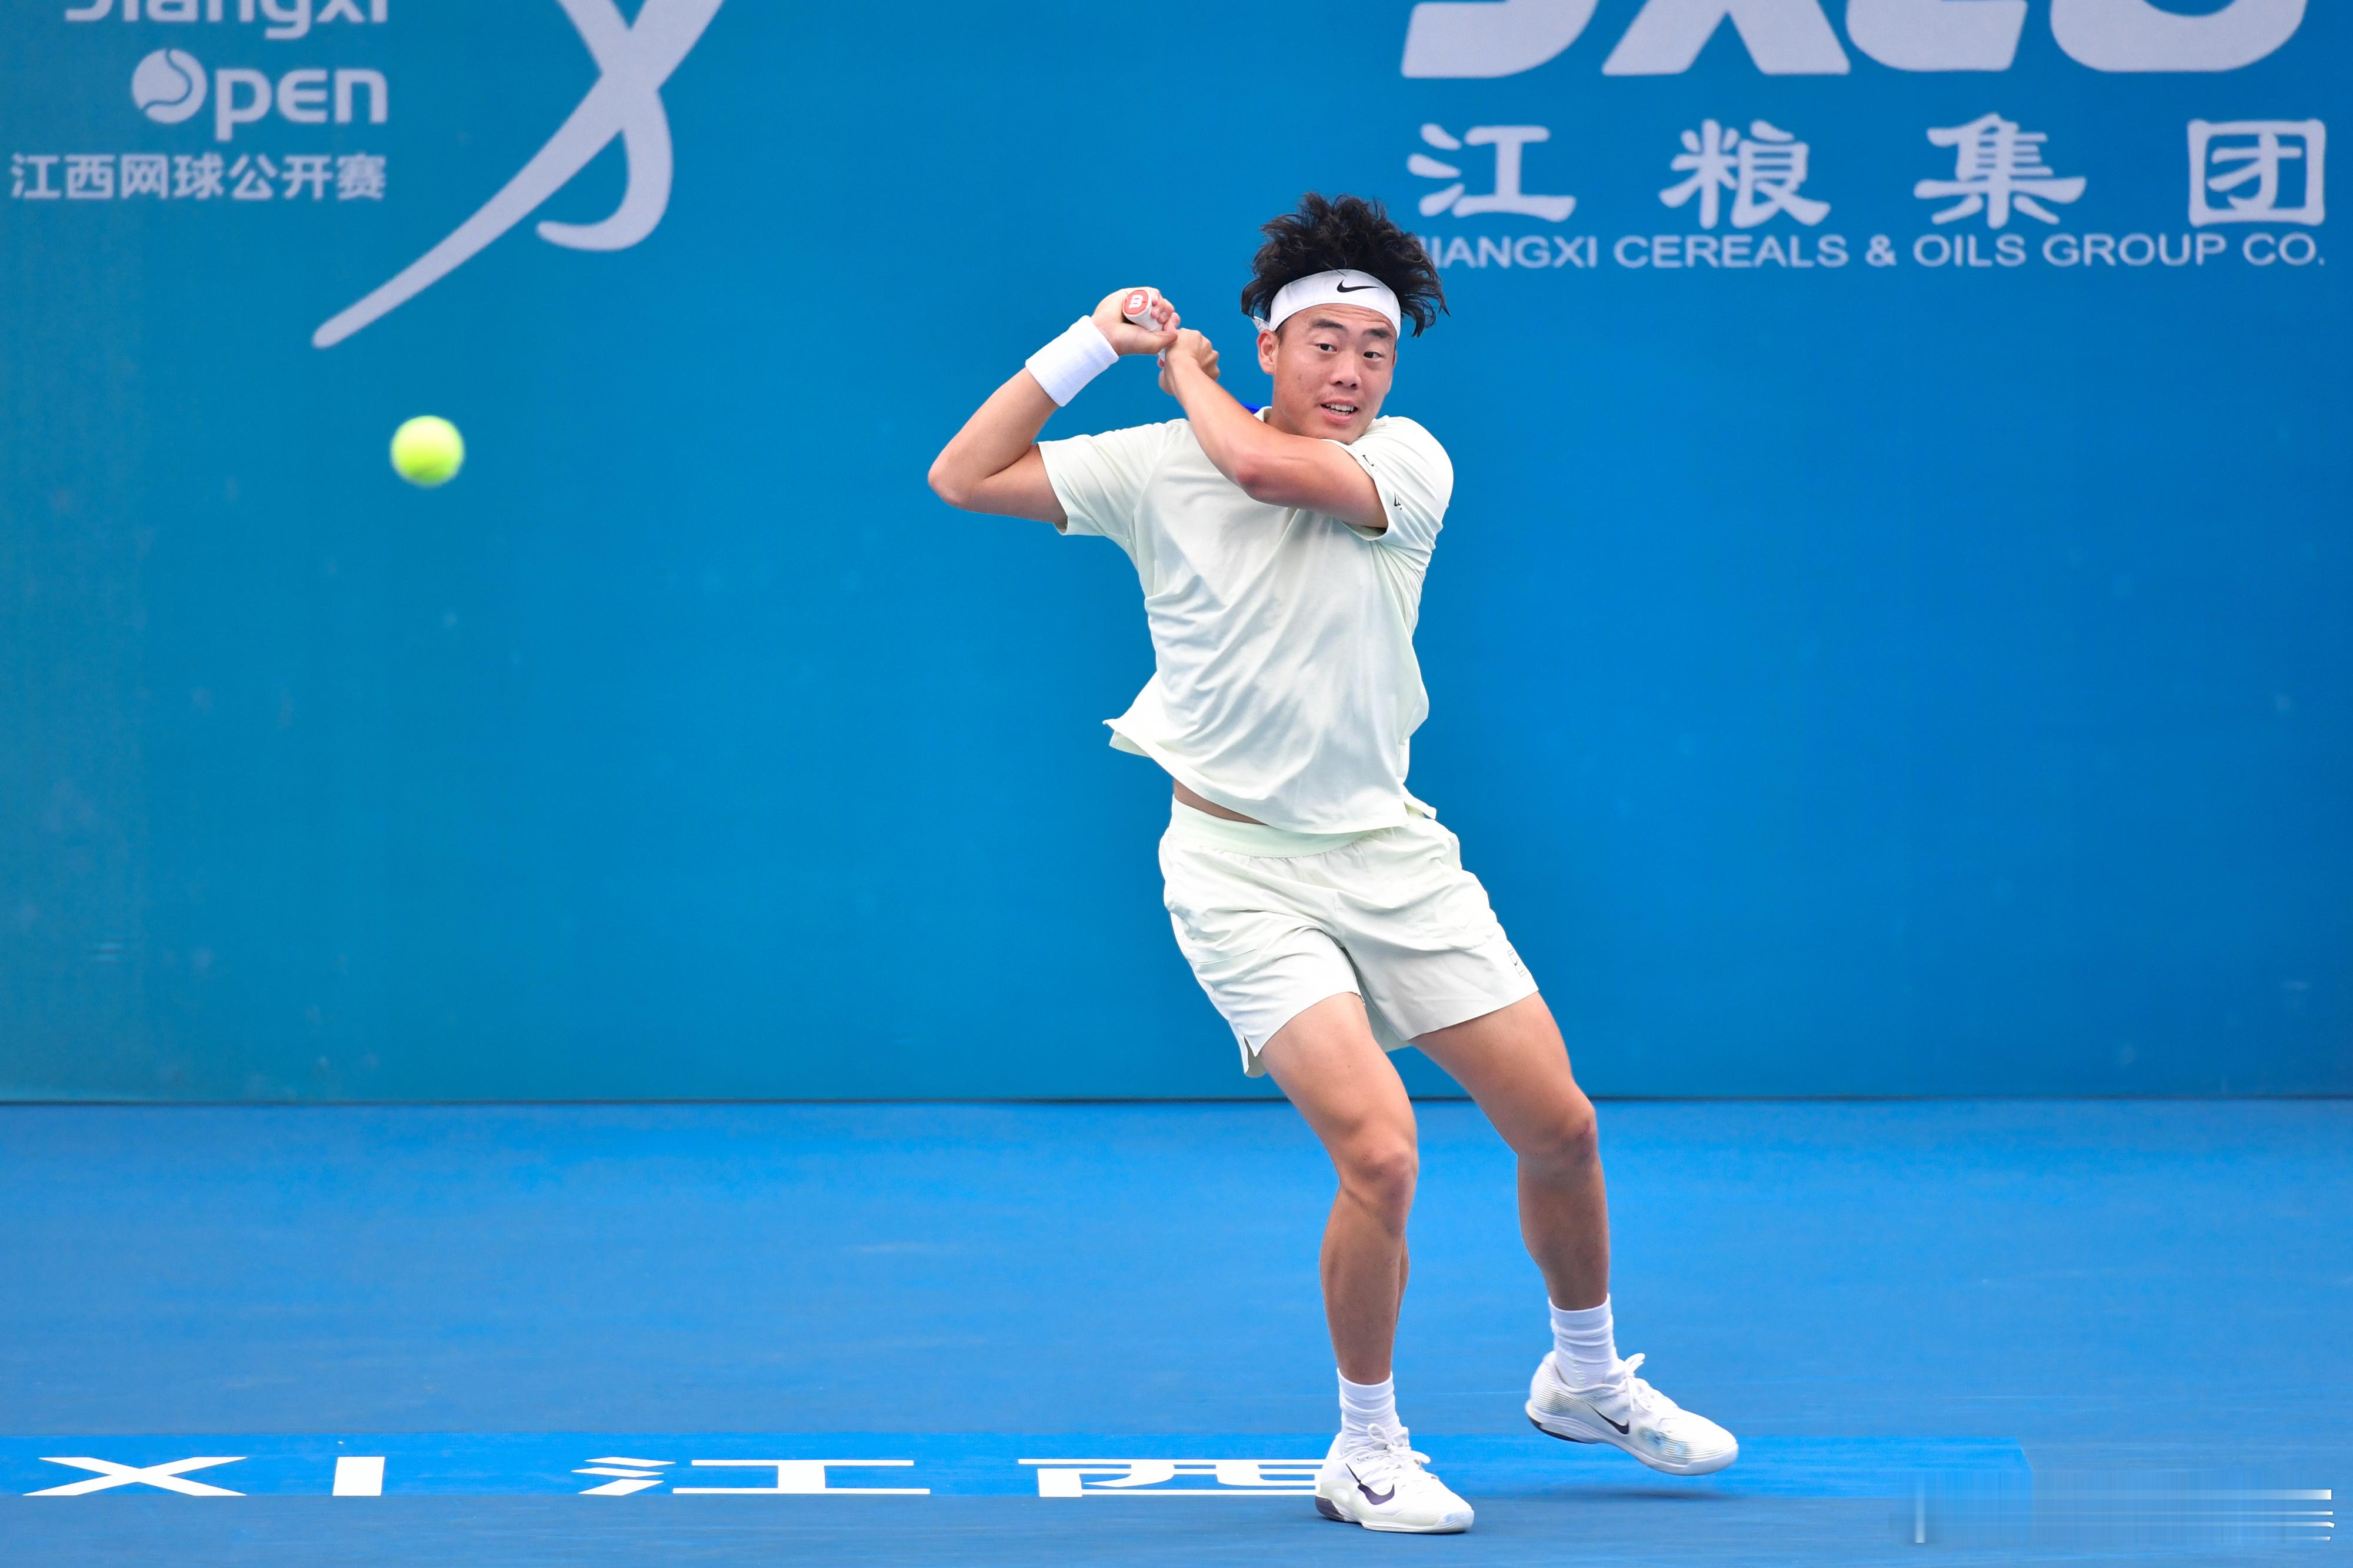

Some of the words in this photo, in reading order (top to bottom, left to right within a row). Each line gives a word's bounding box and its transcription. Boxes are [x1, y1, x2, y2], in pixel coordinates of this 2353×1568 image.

[11, 153, 386, 200] 江西网球公开赛
[1407, 113, 2327, 229] 江粮集团
[1421, 234, 1597, 268] IANGXI
[1614, 234, 1849, 268] CEREALS
[1865, 234, 1895, 268] &
[1914, 233, 2026, 268] OILS
[2042, 233, 2226, 267] GROUP
[2242, 233, 2324, 265] CO.
[25, 1456, 386, 1497] XI
[571, 1457, 1327, 1497] 江西
